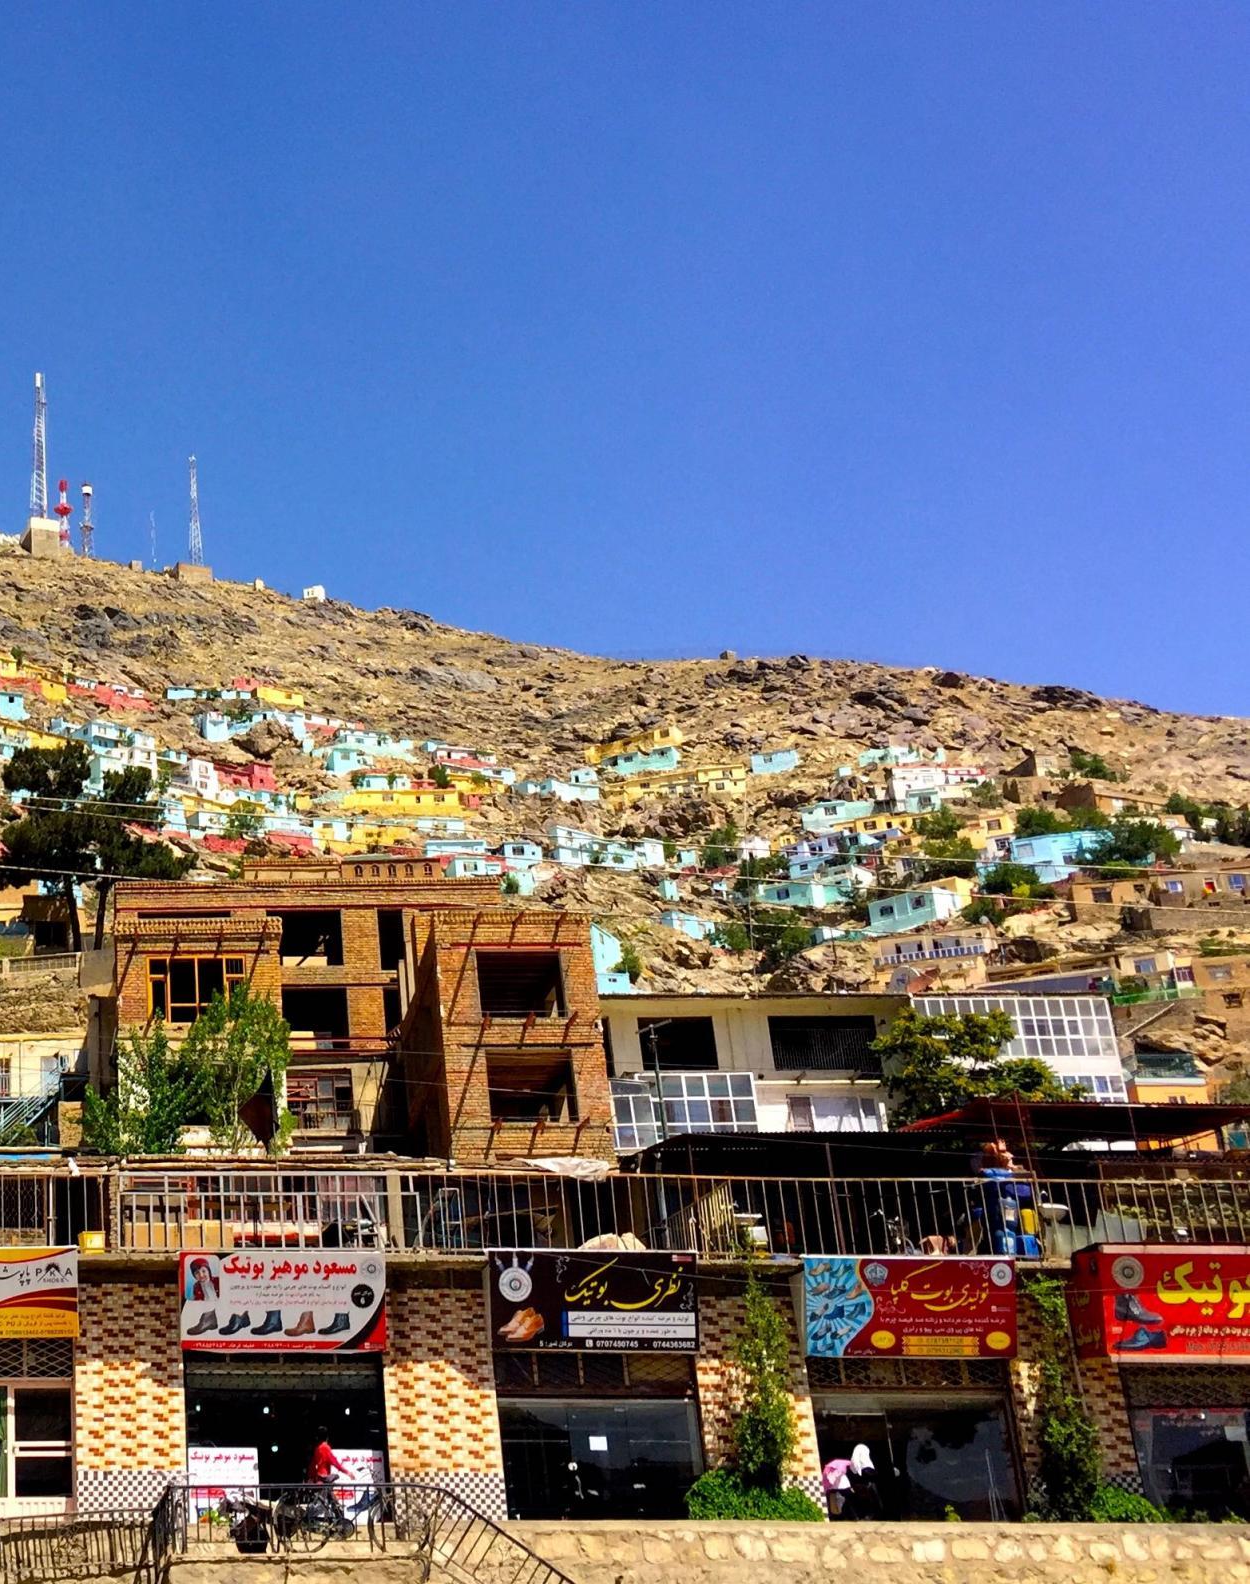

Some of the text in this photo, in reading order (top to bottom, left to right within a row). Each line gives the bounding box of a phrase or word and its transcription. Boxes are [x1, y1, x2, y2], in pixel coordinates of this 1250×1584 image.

[223, 1256, 358, 1281] مسعود موهیز بوتیک
[565, 1256, 683, 1310] نظری بوتیک
[910, 1284, 953, 1303] بوت
[924, 1281, 990, 1311] تولیدی
